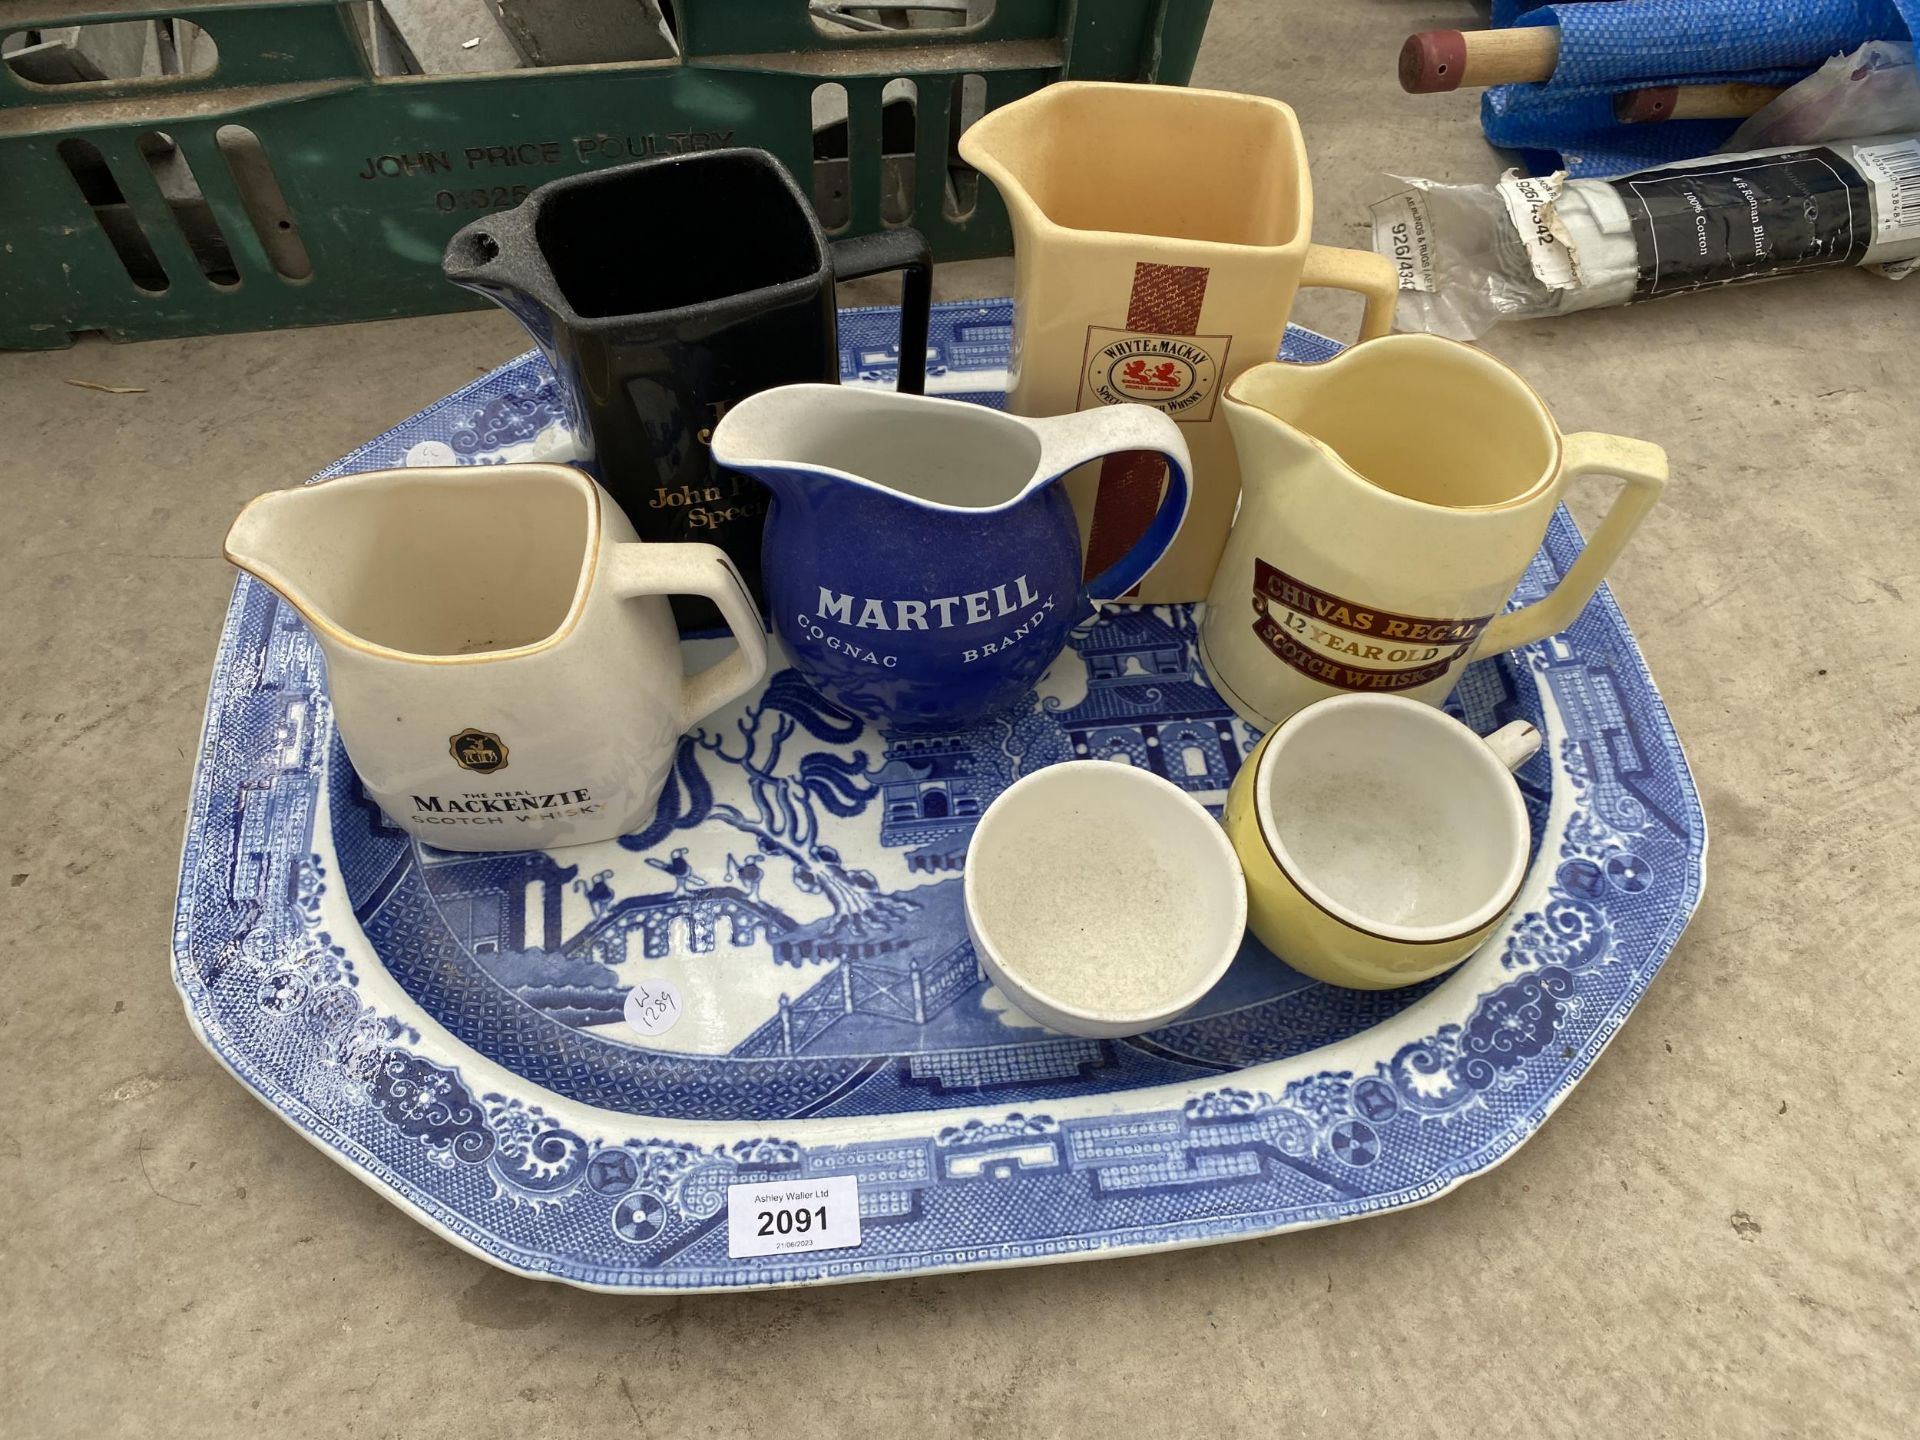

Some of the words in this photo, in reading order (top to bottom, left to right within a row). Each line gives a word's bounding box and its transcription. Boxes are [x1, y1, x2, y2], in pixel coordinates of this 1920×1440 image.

[360, 151, 450, 181] JOHN
[464, 142, 560, 171] PRICE
[573, 130, 736, 163] POULTRY
[1683, 191, 1705, 214] 100%
[1695, 215, 1708, 256] Cotton
[1741, 189, 1760, 224] Roman
[1752, 225, 1766, 257] Blind
[649, 485, 723, 509] John
[815, 574, 1039, 631] MARTELL
[1267, 574, 1375, 631] CHIVAS
[1381, 619, 1478, 642] REGAL
[797, 613, 898, 668] COGNAC
[961, 593, 1055, 664] BRANDY
[1282, 611, 1308, 634] 12
[1309, 624, 1384, 663] YEAR
[1386, 647, 1440, 664] OLD
[1262, 624, 1340, 681] SCOTCH
[1342, 664, 1446, 689] WHISKY
[409, 788, 592, 814] MACKENZIE
[411, 814, 504, 826] SCOTCH
[516, 803, 609, 823] WHISKY
[462, 792, 489, 800] THE
[496, 789, 531, 798] REAL
[754, 1193, 784, 1204] Ashley
[785, 1190, 813, 1201] Waller
[815, 1189, 829, 1199] Ltd
[757, 1205, 827, 1237] 2091
[776, 1239, 814, 1250] 21/06/2023
